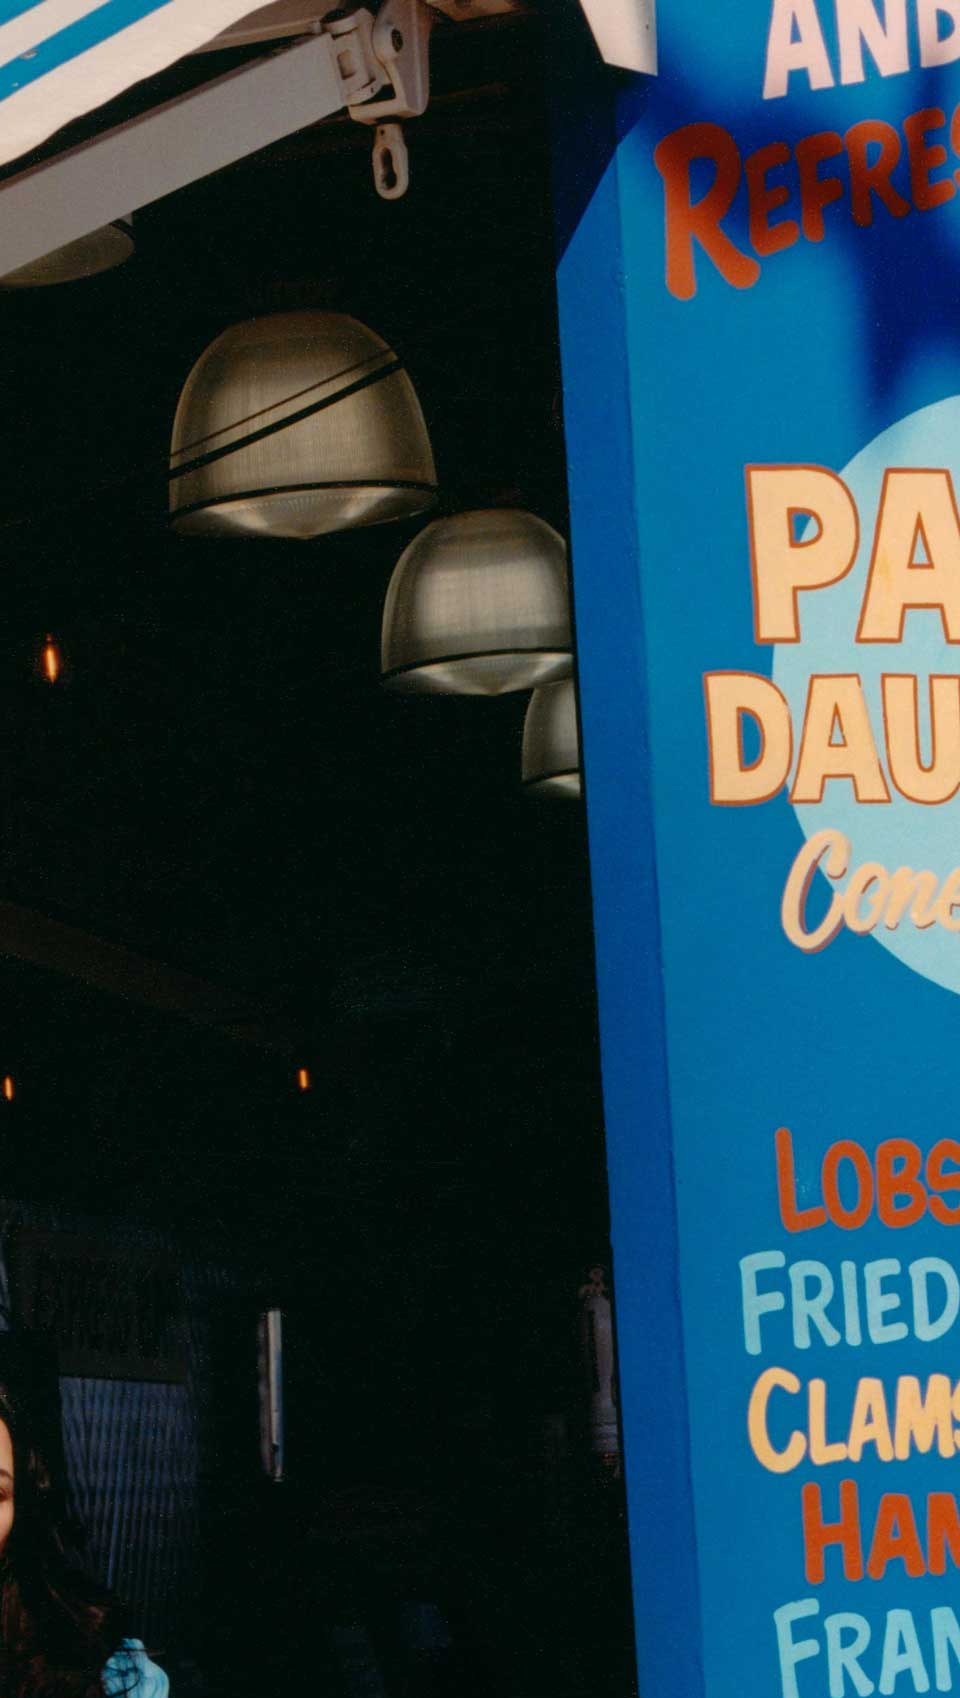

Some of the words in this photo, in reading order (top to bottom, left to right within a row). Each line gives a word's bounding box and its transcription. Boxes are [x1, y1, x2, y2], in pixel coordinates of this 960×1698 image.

[653, 100, 960, 301] REFRE
[775, 1127, 960, 1233] LOBS
[739, 1250, 960, 1356] FRIED
